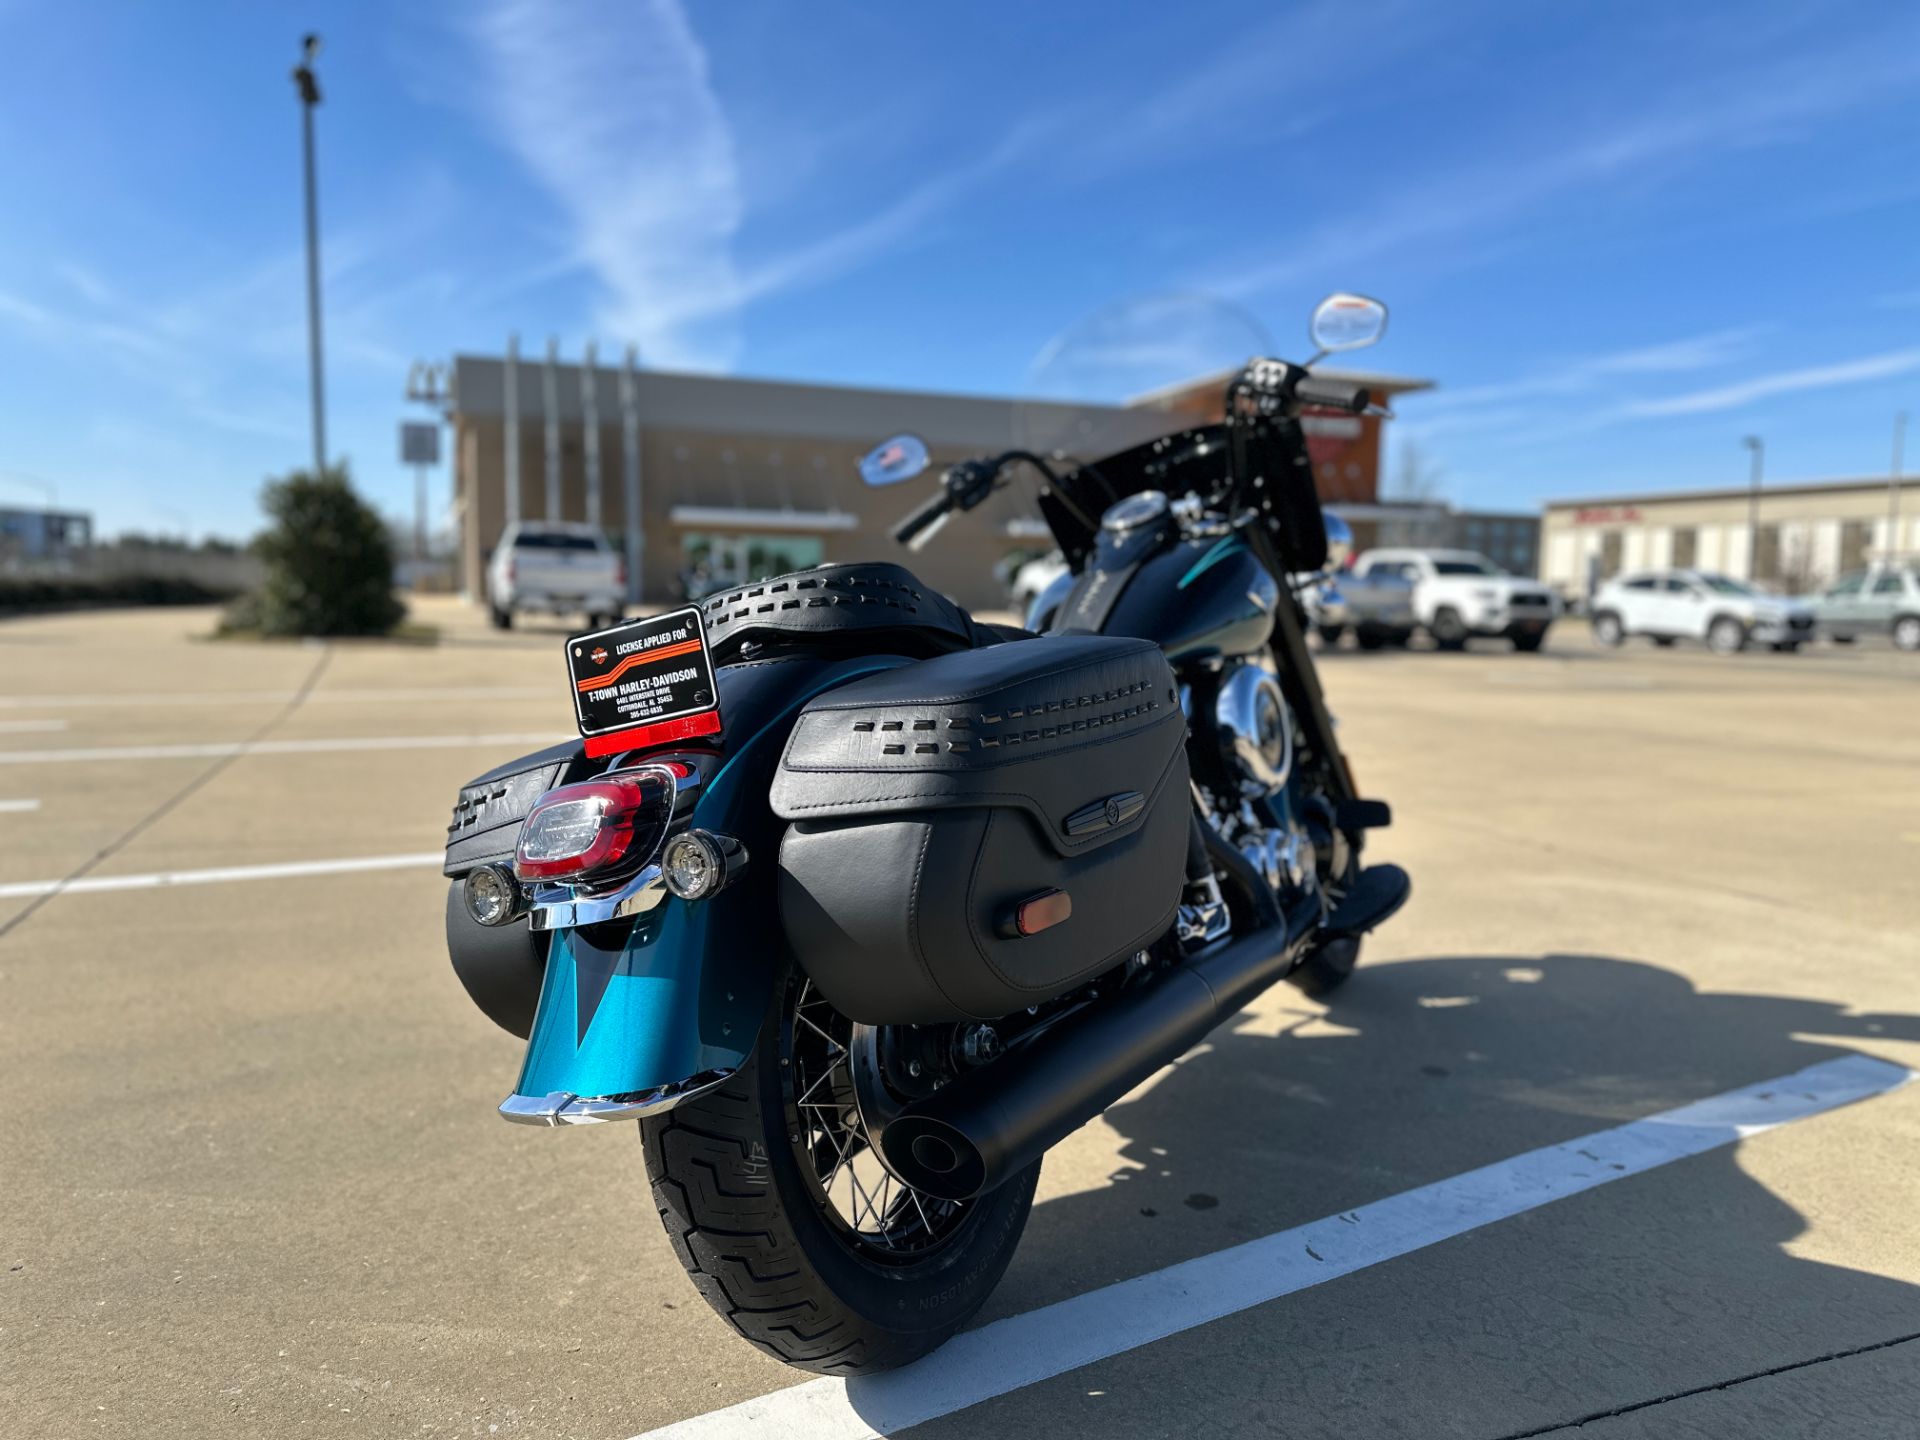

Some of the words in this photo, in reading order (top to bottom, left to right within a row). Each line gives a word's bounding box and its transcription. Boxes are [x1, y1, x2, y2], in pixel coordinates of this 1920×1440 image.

[616, 641, 643, 655] LICENSE
[644, 633, 672, 648] APPLIED
[673, 628, 687, 640] FOR
[588, 687, 618, 702] T-TOWN
[619, 667, 698, 695] HARLEY-DAVIDSON
[629, 691, 655, 702] INTERSTATE
[656, 687, 671, 696] DRIVE
[657, 695, 673, 704] 35453
